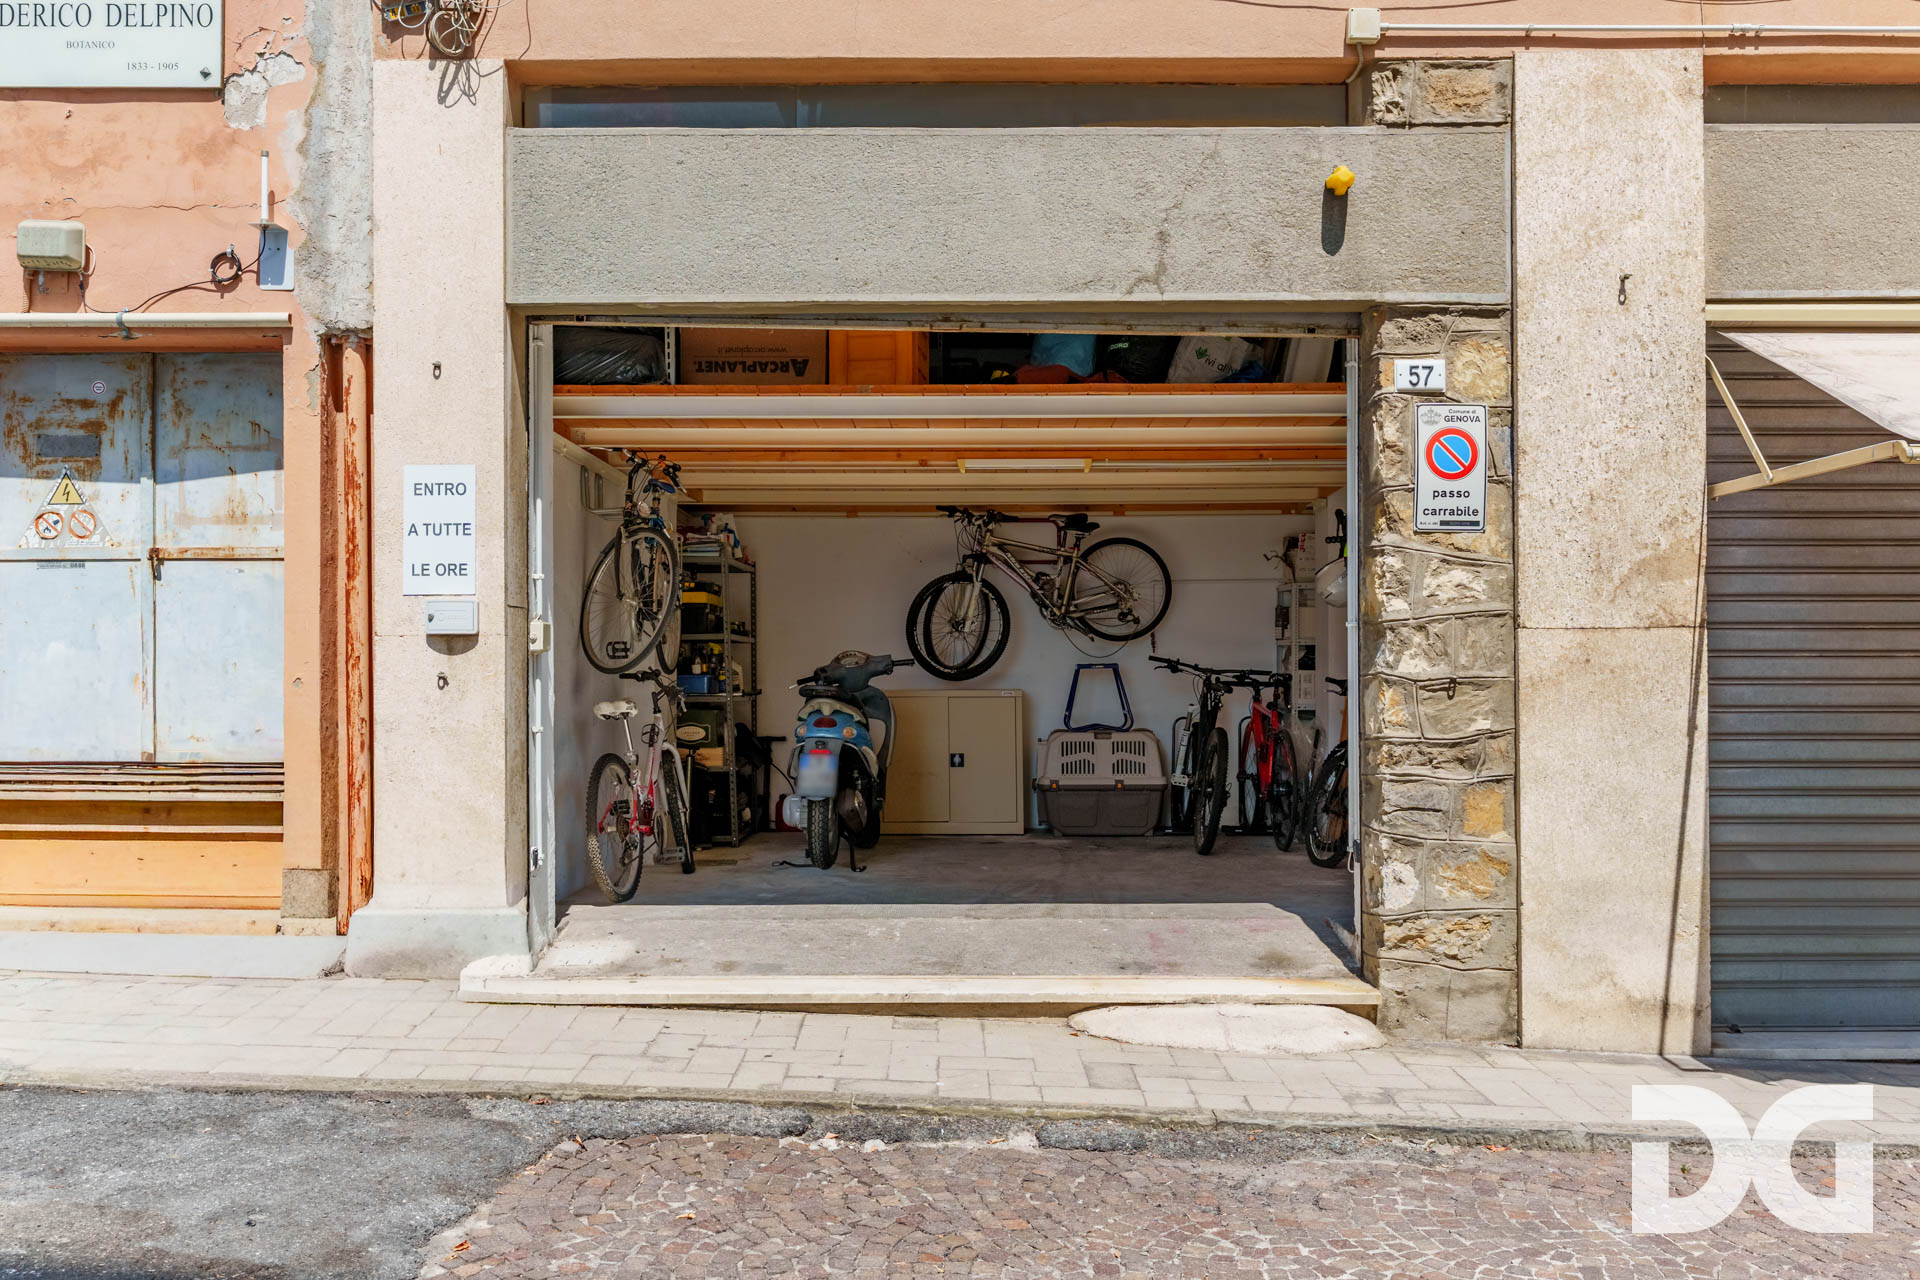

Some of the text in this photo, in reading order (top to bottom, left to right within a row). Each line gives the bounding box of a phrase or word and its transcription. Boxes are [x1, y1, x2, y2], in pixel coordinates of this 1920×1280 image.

[106, 3, 214, 28] DELPINO
[66, 40, 115, 49] BOTANICO
[127, 62, 148, 71] 1833
[157, 62, 179, 71] 1905
[1408, 365, 1434, 387] 57
[1444, 415, 1481, 423] GENOVA
[413, 482, 467, 496] ENTRO
[1432, 489, 1471, 500] passo
[1422, 506, 1479, 517] carrabile
[407, 523, 472, 537] A TUTTE
[411, 563, 468, 577] LE ORE
